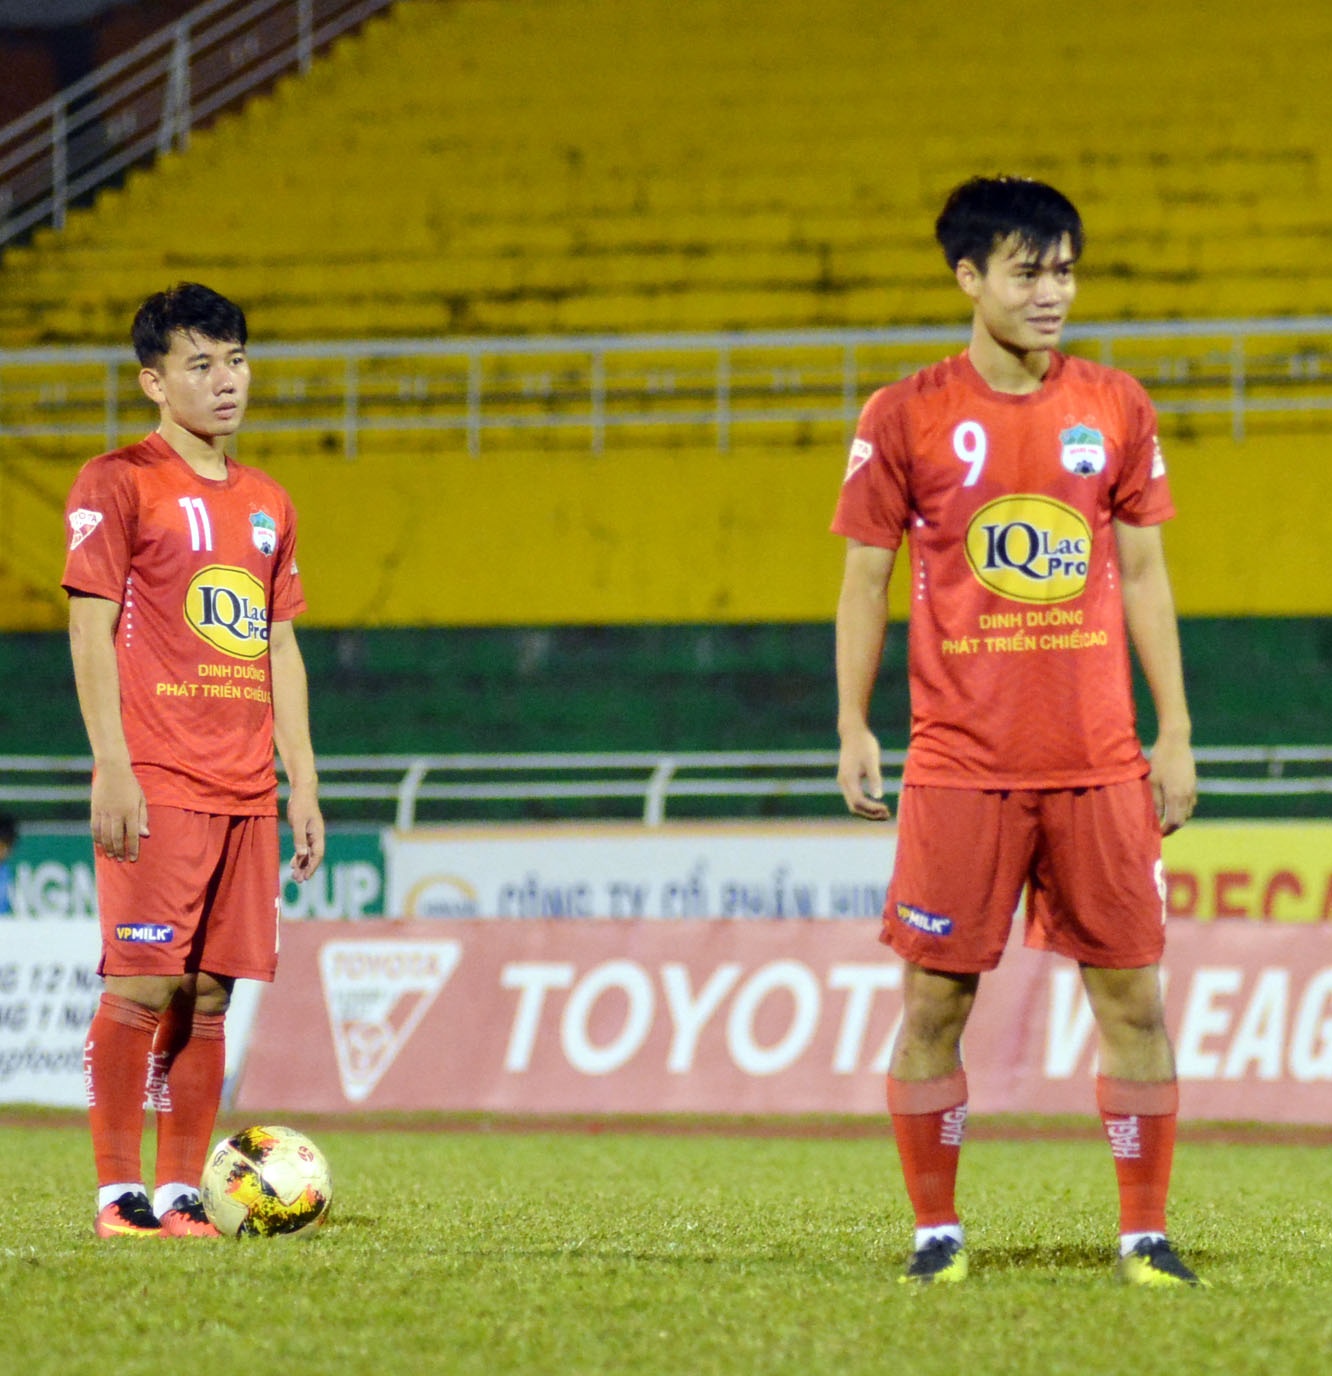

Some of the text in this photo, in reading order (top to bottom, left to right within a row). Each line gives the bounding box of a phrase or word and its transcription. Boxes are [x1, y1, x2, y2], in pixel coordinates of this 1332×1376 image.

[953, 421, 987, 487] 9
[179, 496, 212, 551] 11
[982, 522, 1050, 579] IQ
[1041, 532, 1085, 555] Lac
[1048, 557, 1087, 577] Pro
[197, 587, 250, 639] IQ
[979, 612, 1022, 629] DINH
[198, 664, 231, 677] DINH
[156, 680, 199, 697] PHÁT
[116, 926, 172, 940] VPMILK
